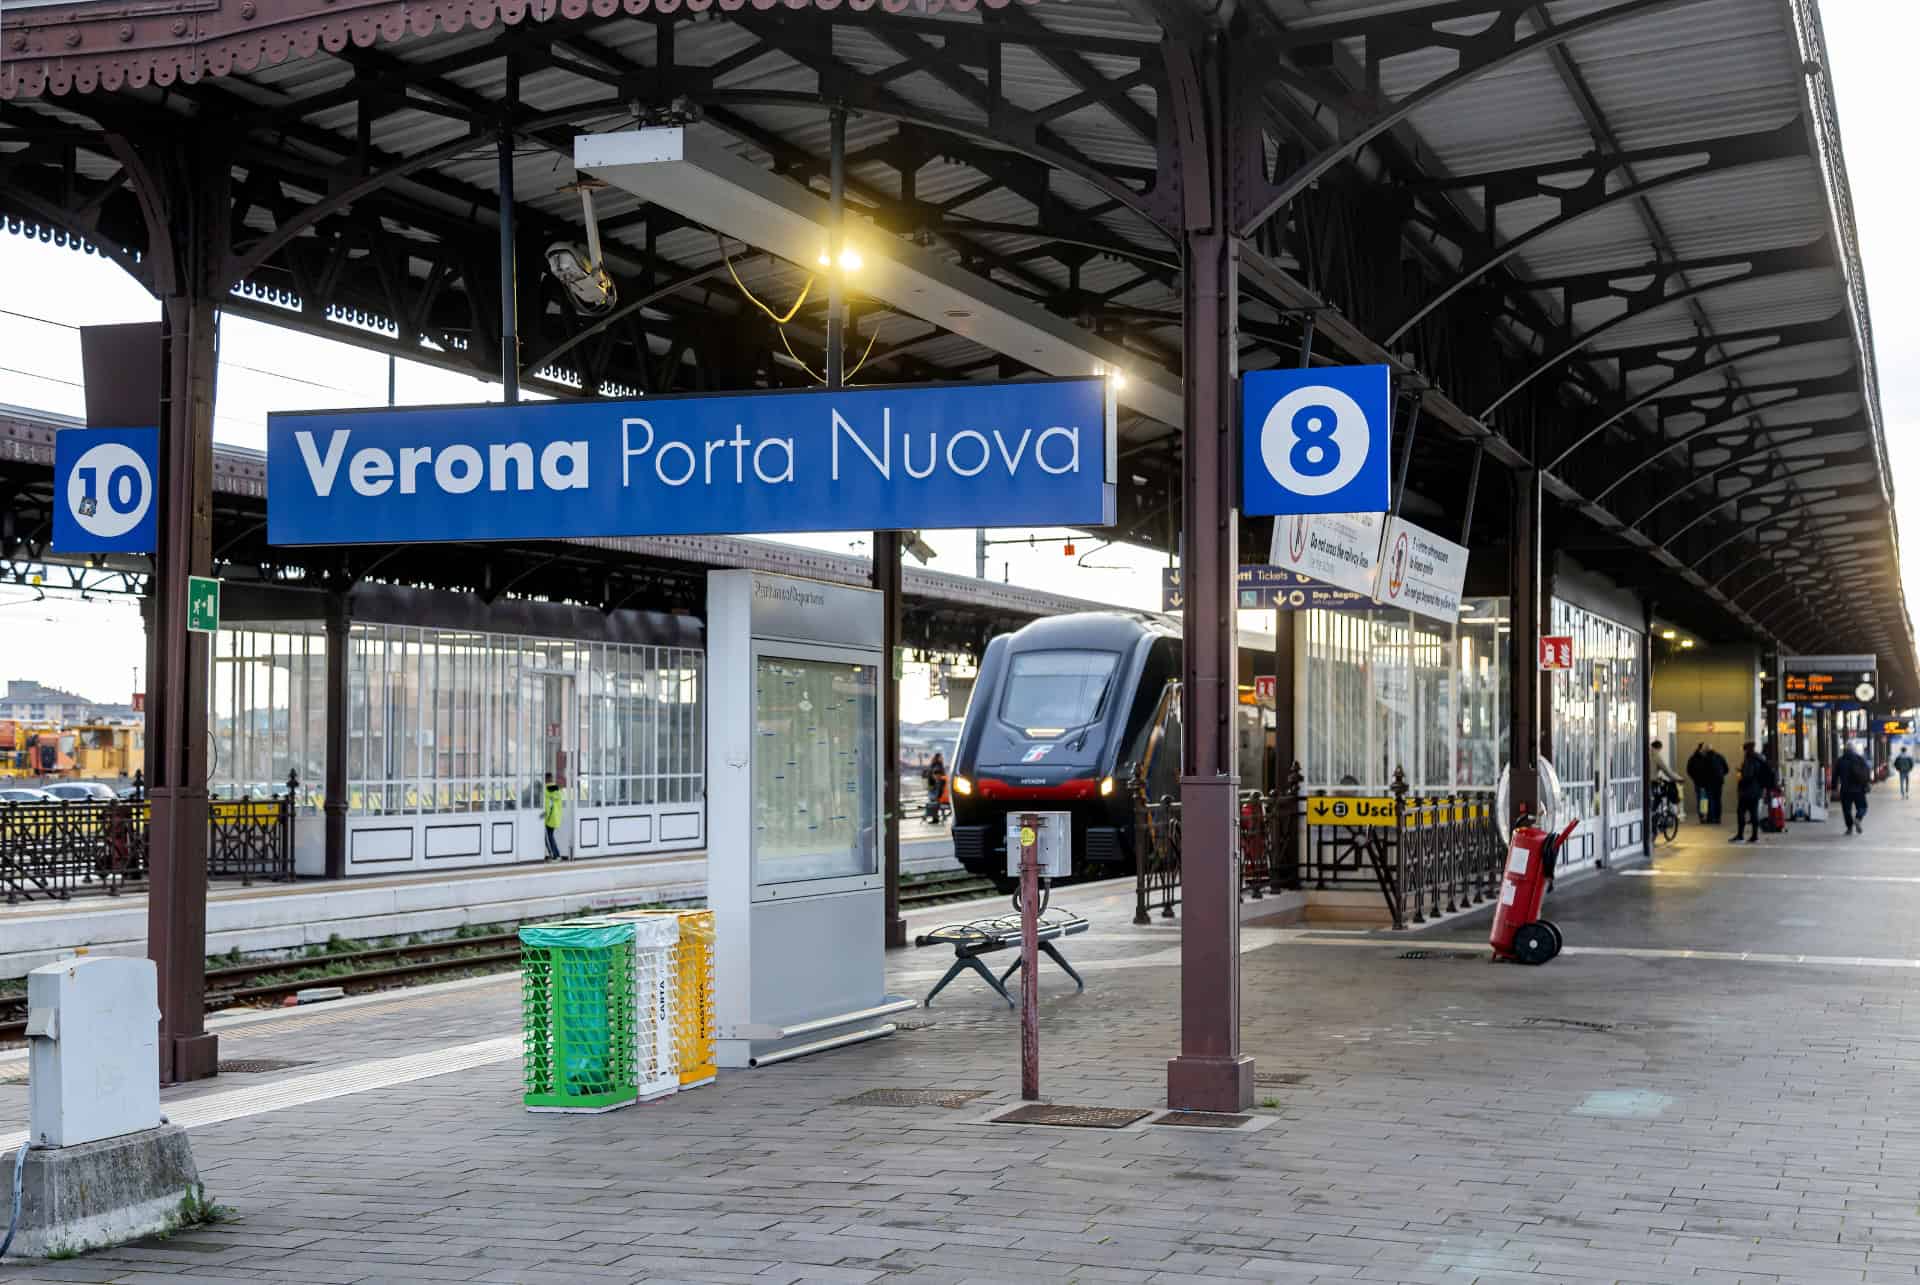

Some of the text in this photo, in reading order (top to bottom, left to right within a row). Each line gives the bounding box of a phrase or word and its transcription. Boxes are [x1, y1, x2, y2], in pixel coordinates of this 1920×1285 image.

[294, 407, 1079, 497] Verona Porta Nuova
[1289, 404, 1341, 477] 8
[78, 464, 143, 514] 10
[1310, 532, 1317, 550] Do
[1318, 538, 1327, 553] not
[1257, 569, 1288, 581] Tickets
